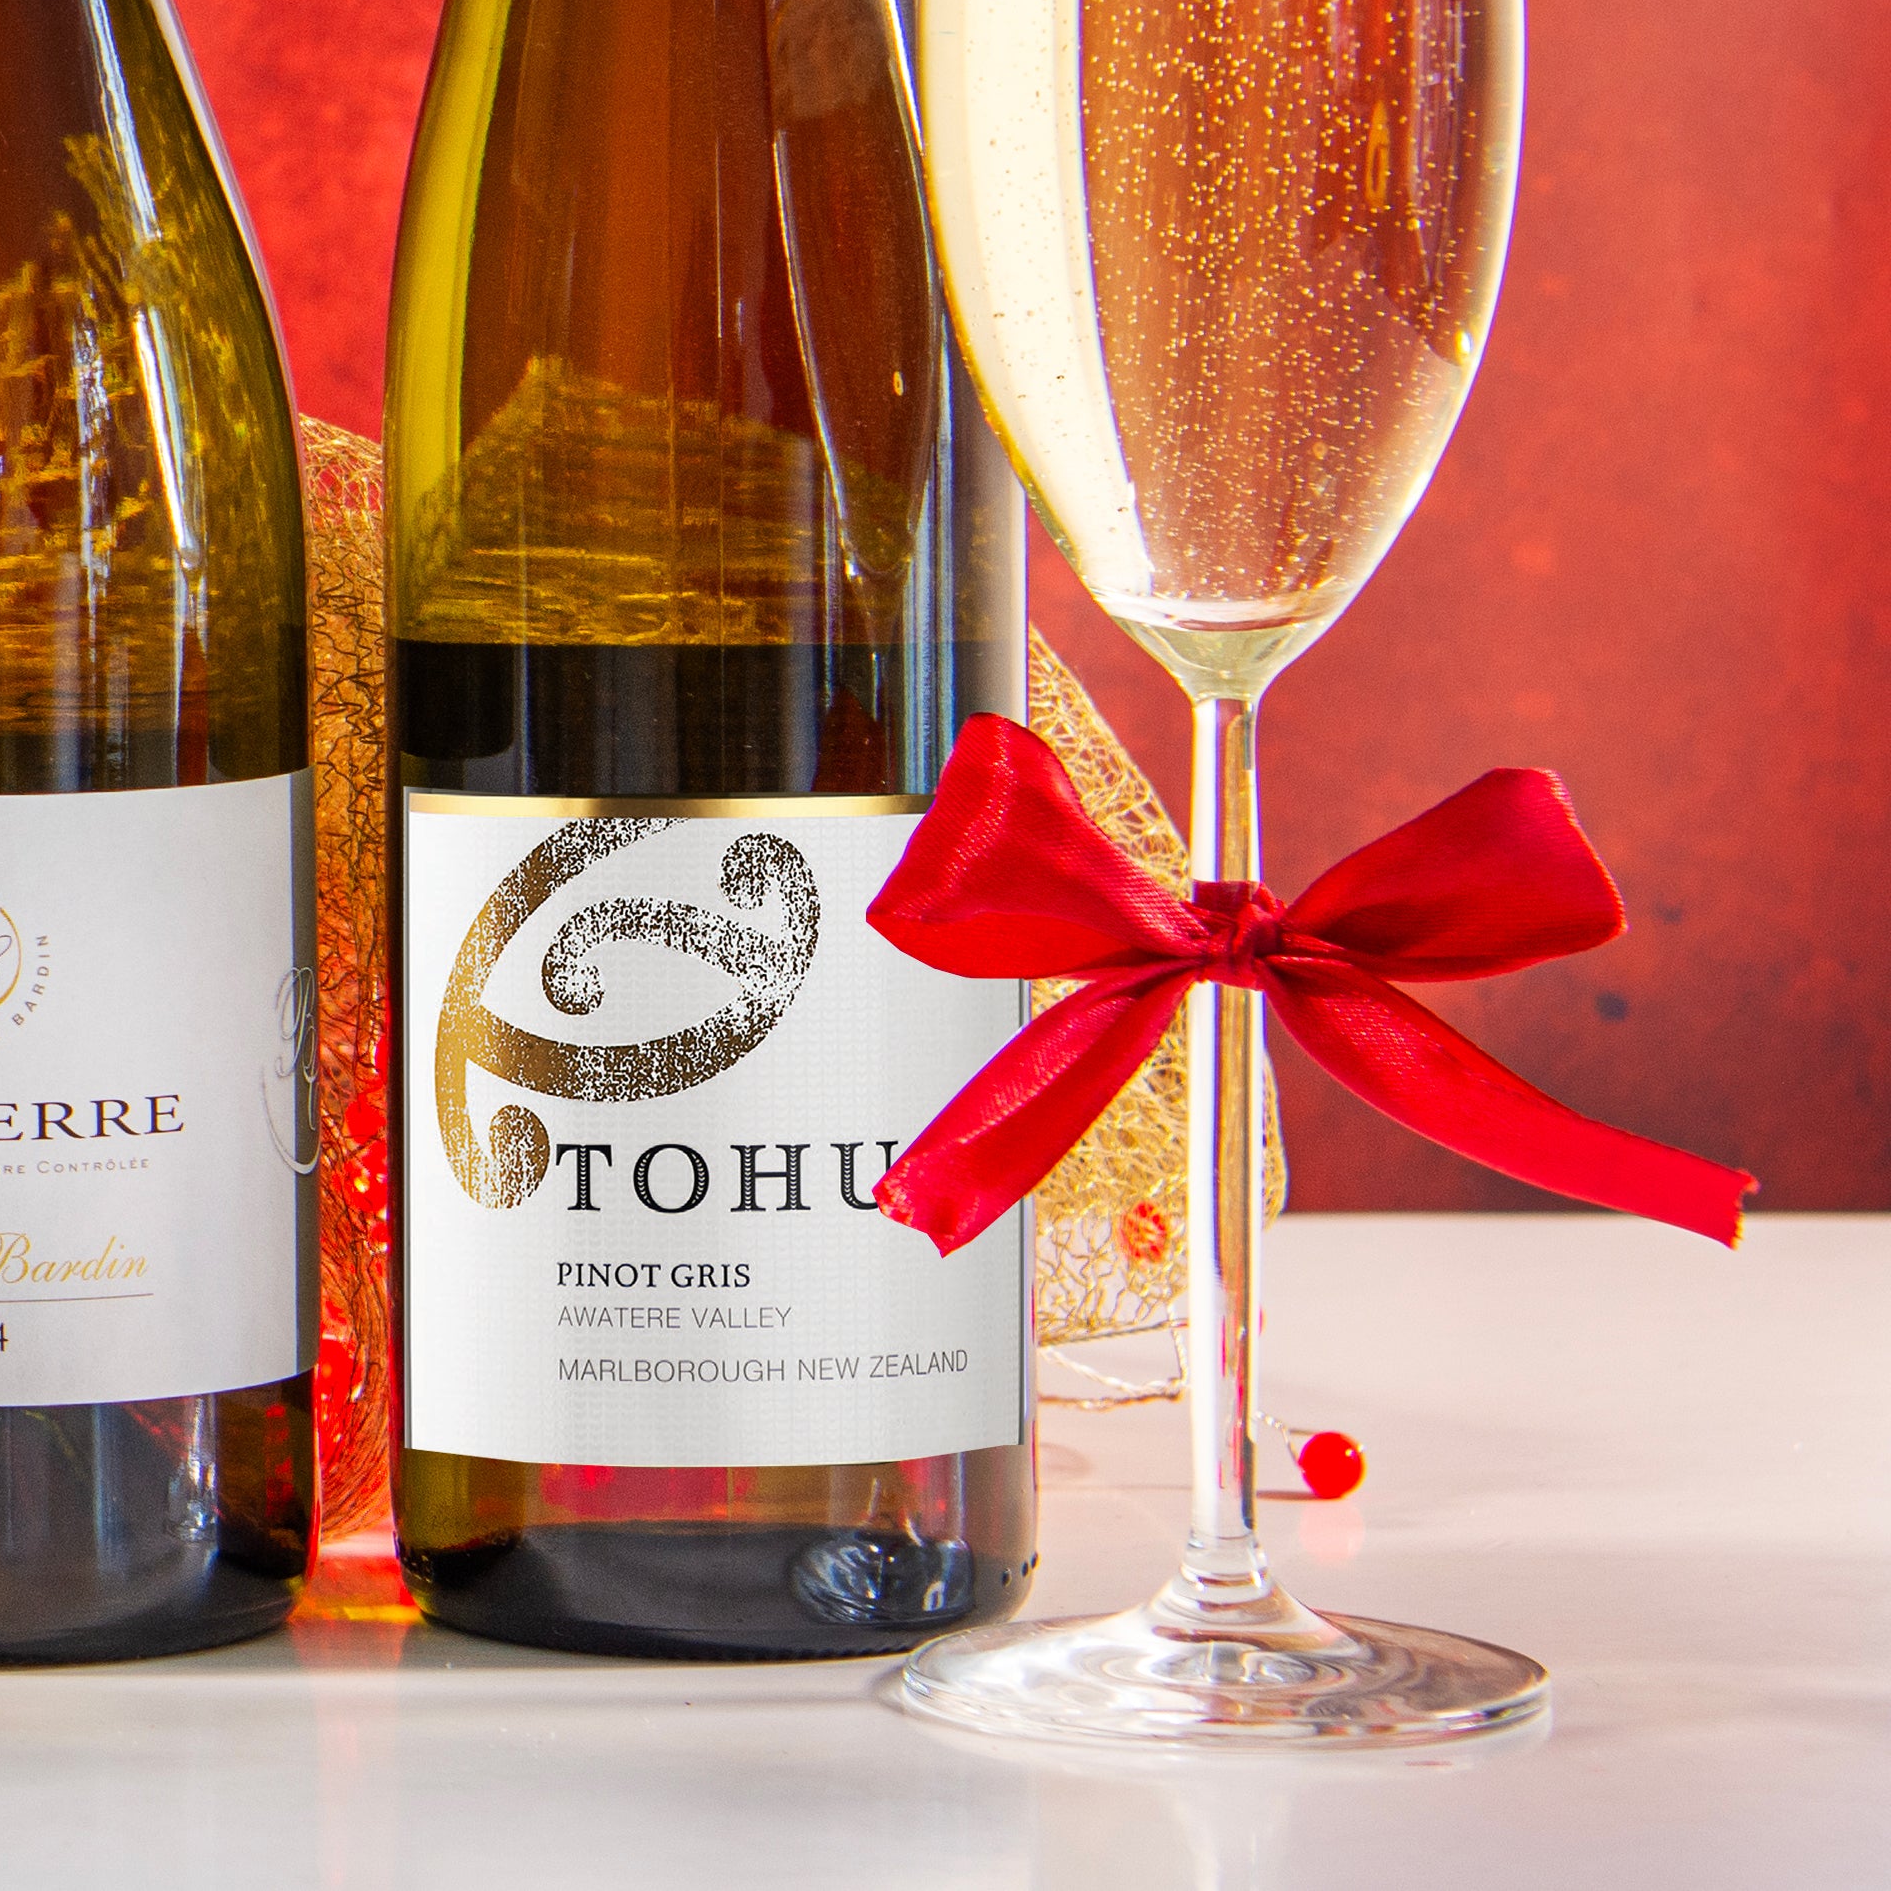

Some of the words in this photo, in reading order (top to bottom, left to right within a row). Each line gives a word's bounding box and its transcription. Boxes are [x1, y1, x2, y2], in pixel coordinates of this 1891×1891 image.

[11, 934, 51, 1026] BARDIN
[556, 1139, 900, 1214] TOHU
[556, 1262, 661, 1289] PINOT
[670, 1262, 751, 1289] GRIS
[557, 1306, 681, 1329] AWATERE
[692, 1305, 793, 1329] VALLEY
[557, 1357, 786, 1383] MARLBOROUGH
[797, 1356, 860, 1382] NEW
[869, 1349, 969, 1379] ZEALAND
